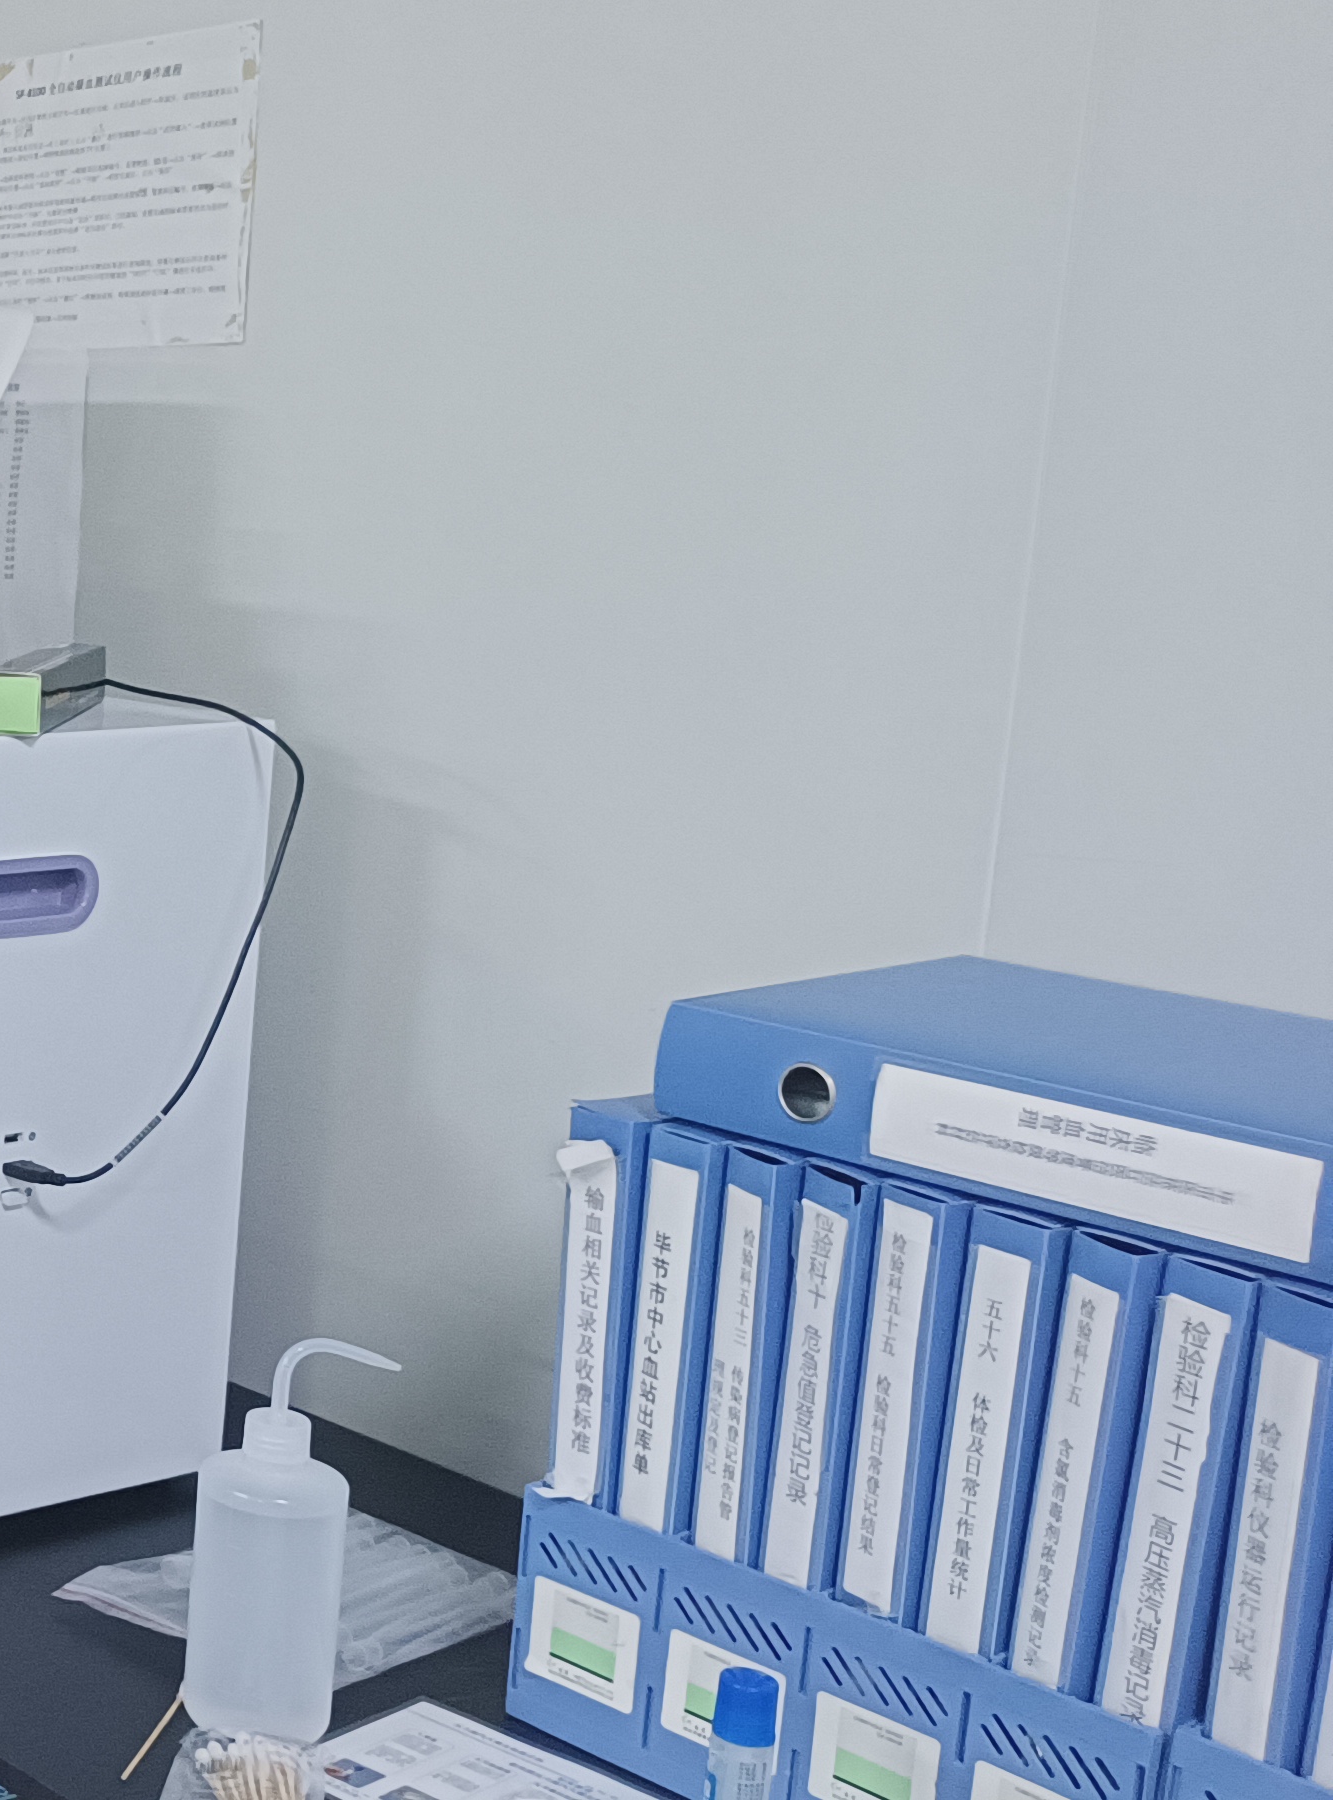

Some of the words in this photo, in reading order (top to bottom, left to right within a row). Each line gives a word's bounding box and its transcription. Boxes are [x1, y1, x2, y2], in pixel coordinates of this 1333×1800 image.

[571, 1186, 605, 1455] 输血相关记录及收费标准
[632, 1230, 672, 1475] 毕节市中心血站出库单
[881, 1232, 906, 1357] 检验科五十五
[978, 1298, 1003, 1363] 五十六
[1066, 1298, 1097, 1408] 检验科十五
[786, 1325, 822, 1506] 危急值登记记录
[1156, 1316, 1211, 1492] 检验科二十三
[947, 1392, 991, 1600] 体检及日常工作量统计
[1228, 1418, 1283, 1682] 检验科仪器运行记录
